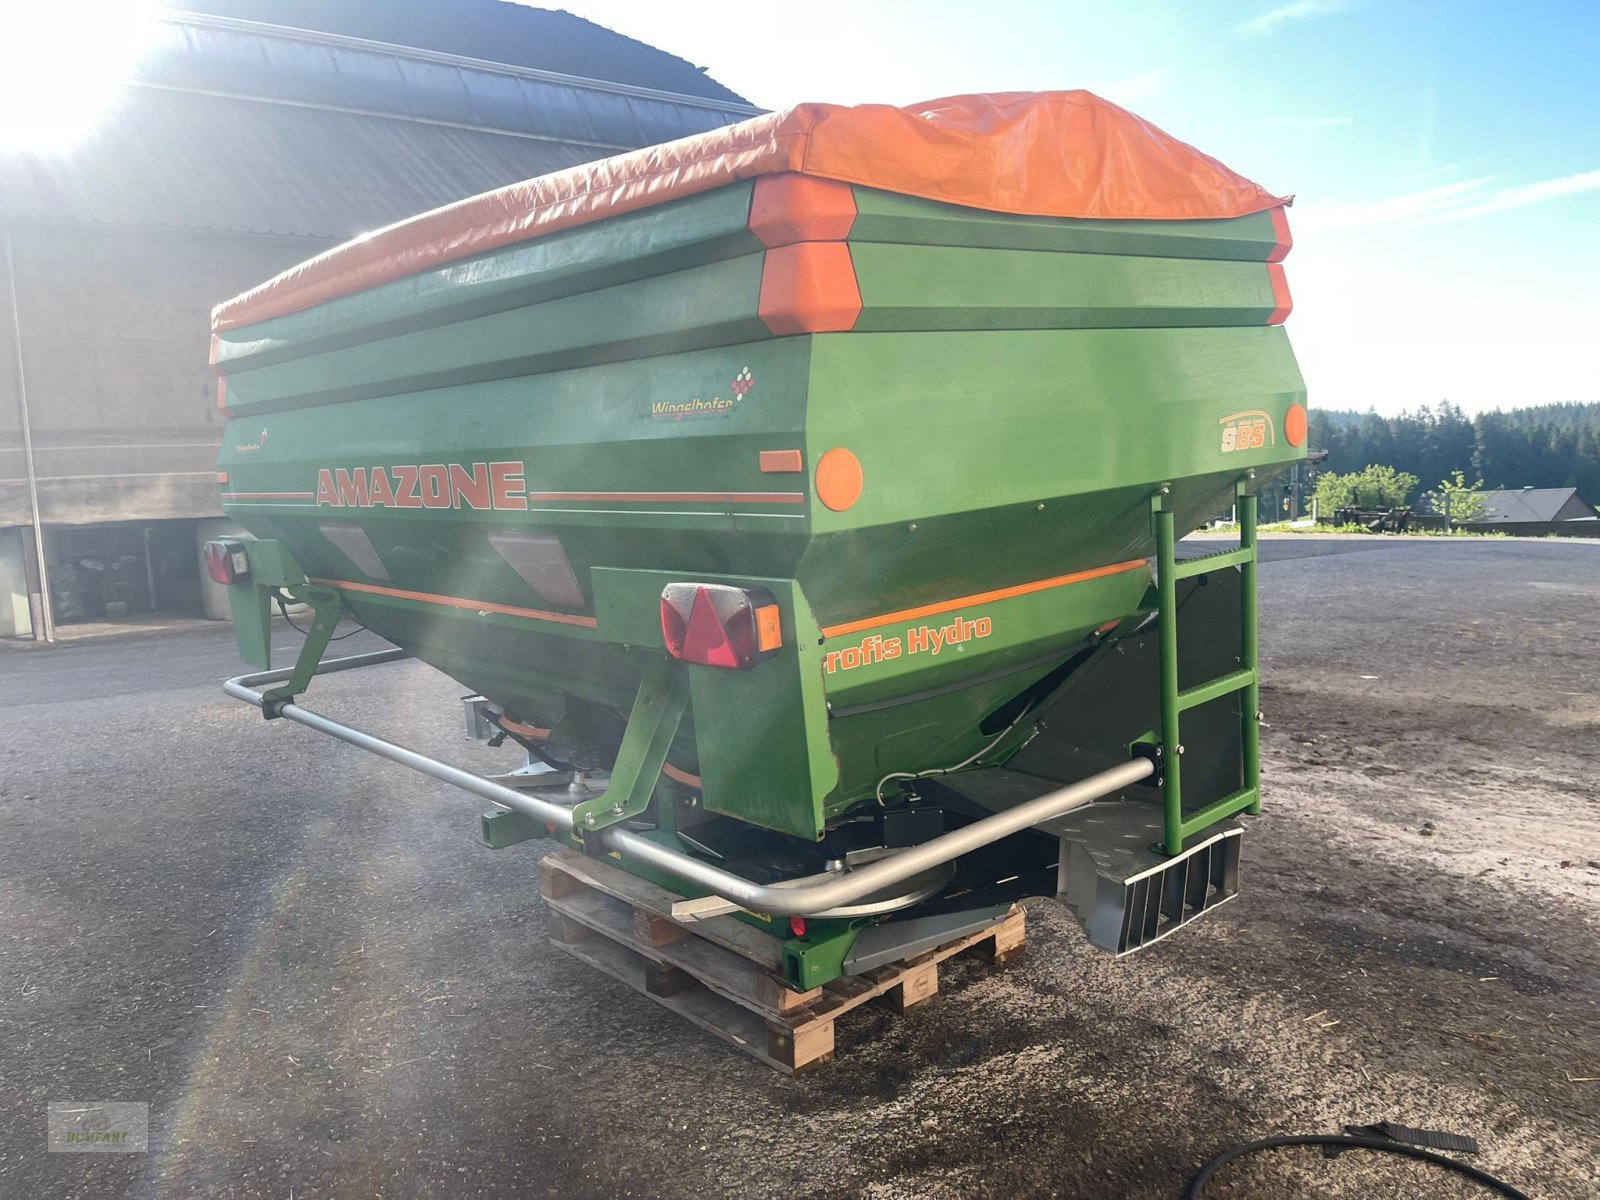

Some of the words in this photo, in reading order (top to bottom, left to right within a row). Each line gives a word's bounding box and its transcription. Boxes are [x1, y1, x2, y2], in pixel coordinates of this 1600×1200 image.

[1221, 424, 1265, 452] SBS
[316, 461, 528, 511] AMAZONE
[822, 635, 902, 674] rofis
[907, 616, 992, 656] Hydro
